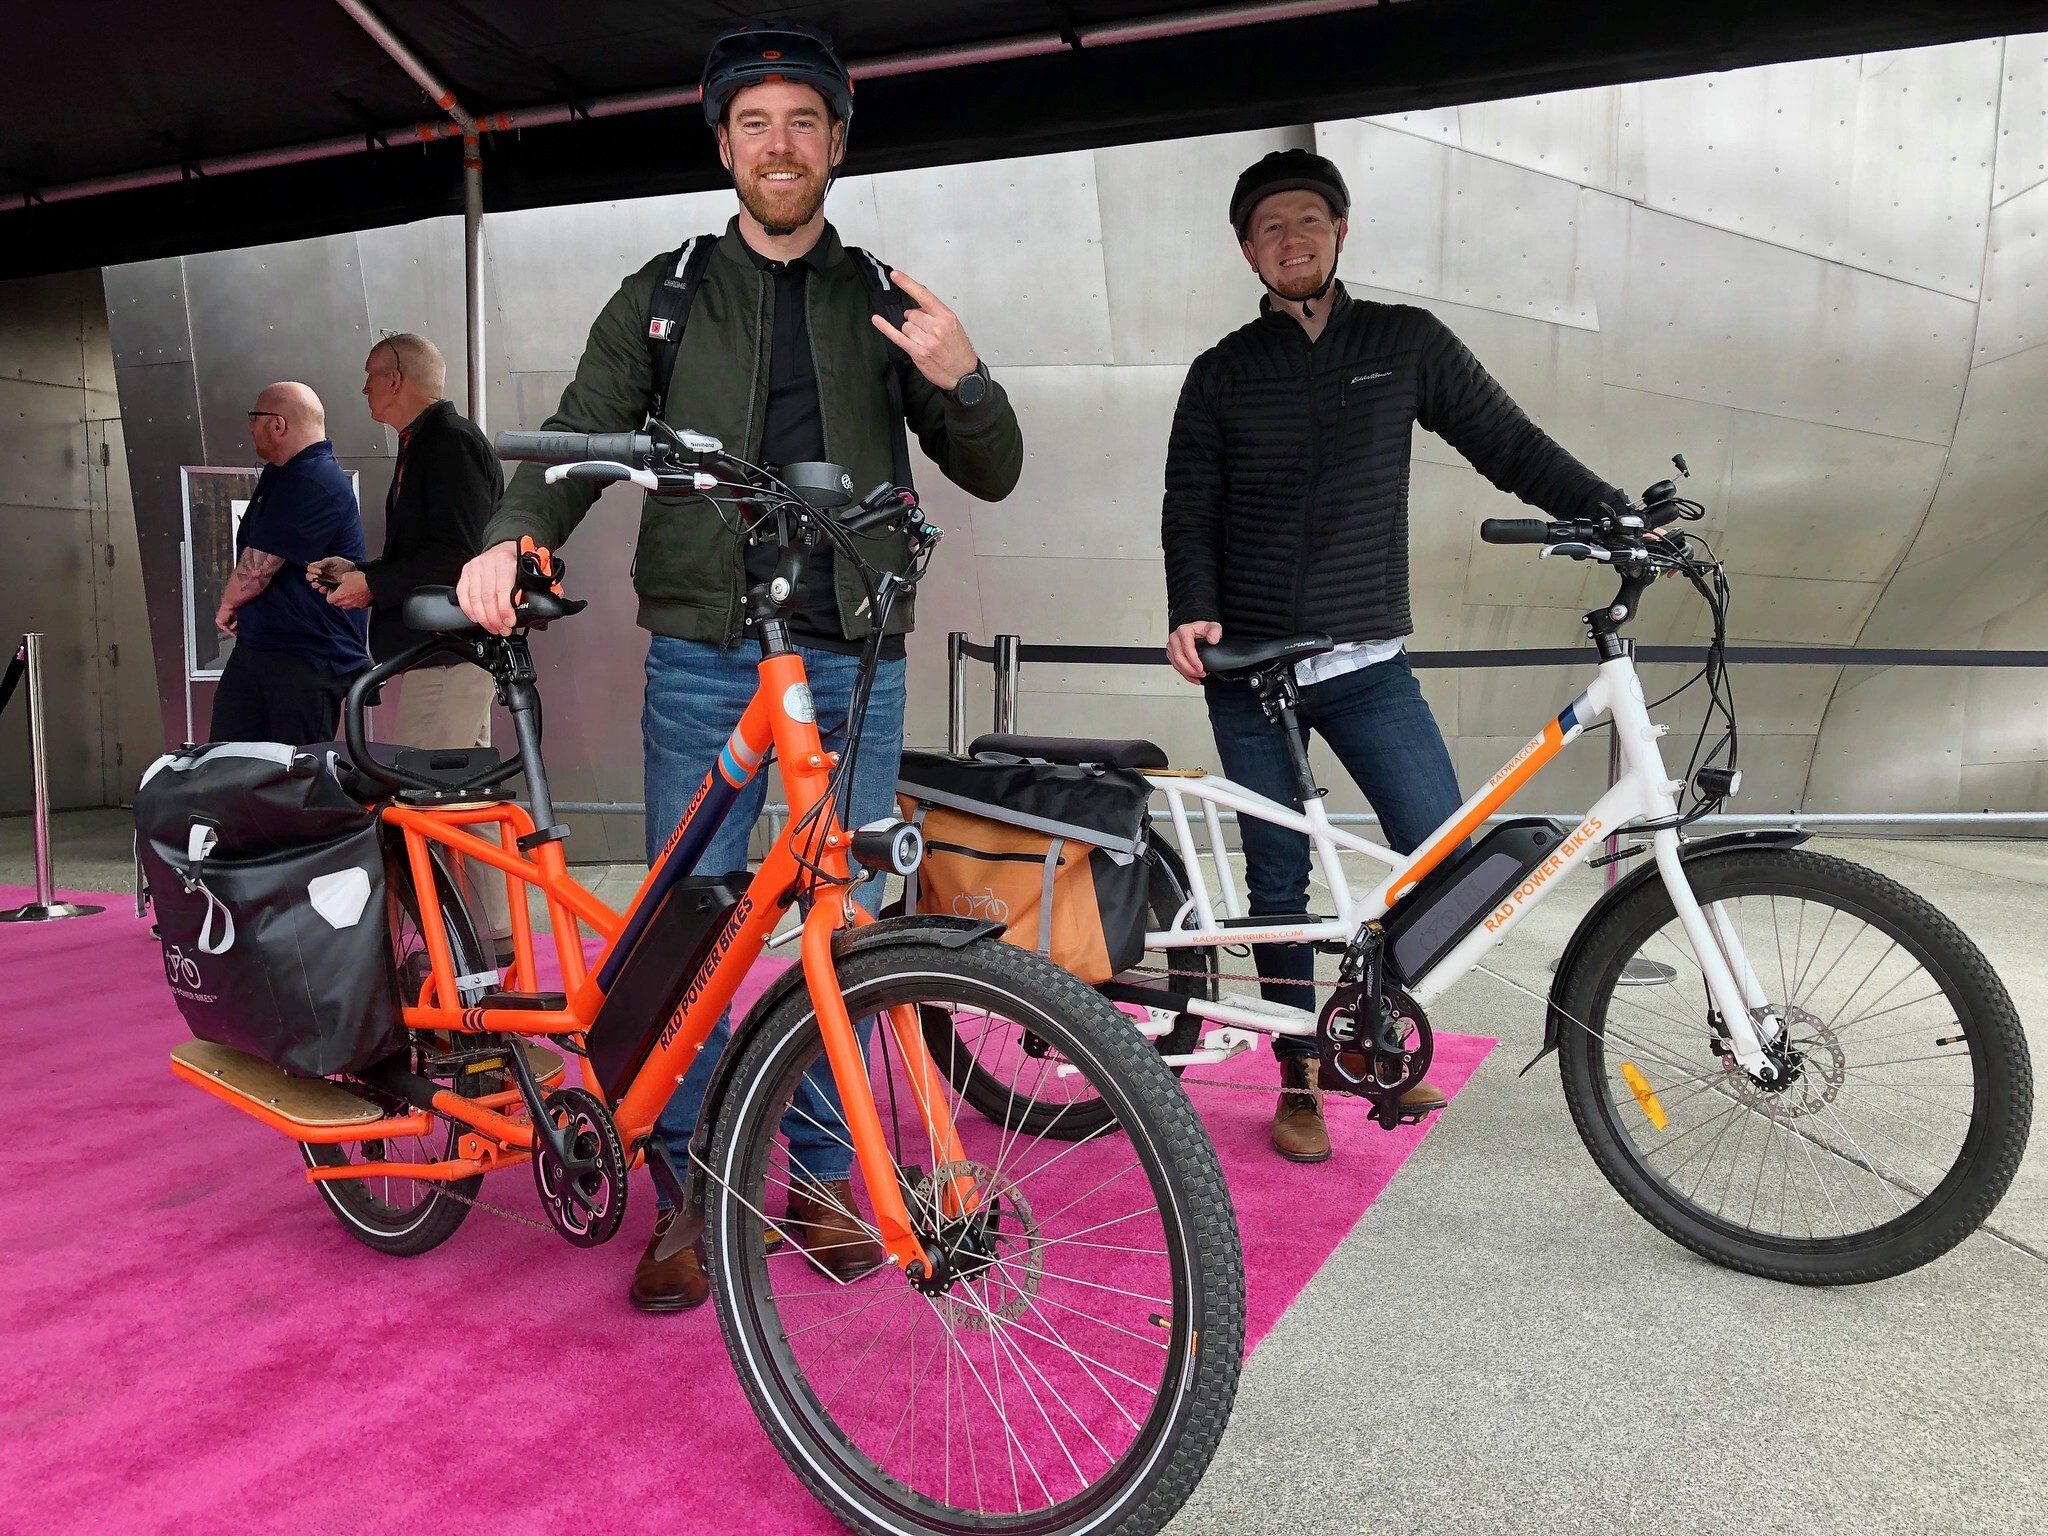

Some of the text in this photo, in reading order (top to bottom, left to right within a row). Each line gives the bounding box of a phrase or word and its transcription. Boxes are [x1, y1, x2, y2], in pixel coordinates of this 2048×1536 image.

[663, 280, 687, 290] CHROME
[1489, 738, 1540, 787] RADWAGON
[663, 779, 708, 858] RADWAGON
[1484, 903, 1515, 932] RAD
[1512, 855, 1563, 904] POWER
[1560, 816, 1602, 858] BIKES
[1192, 930, 1304, 943] RADPOWERBIKES.COM
[660, 894, 753, 1051] RAD POWER BIKES
